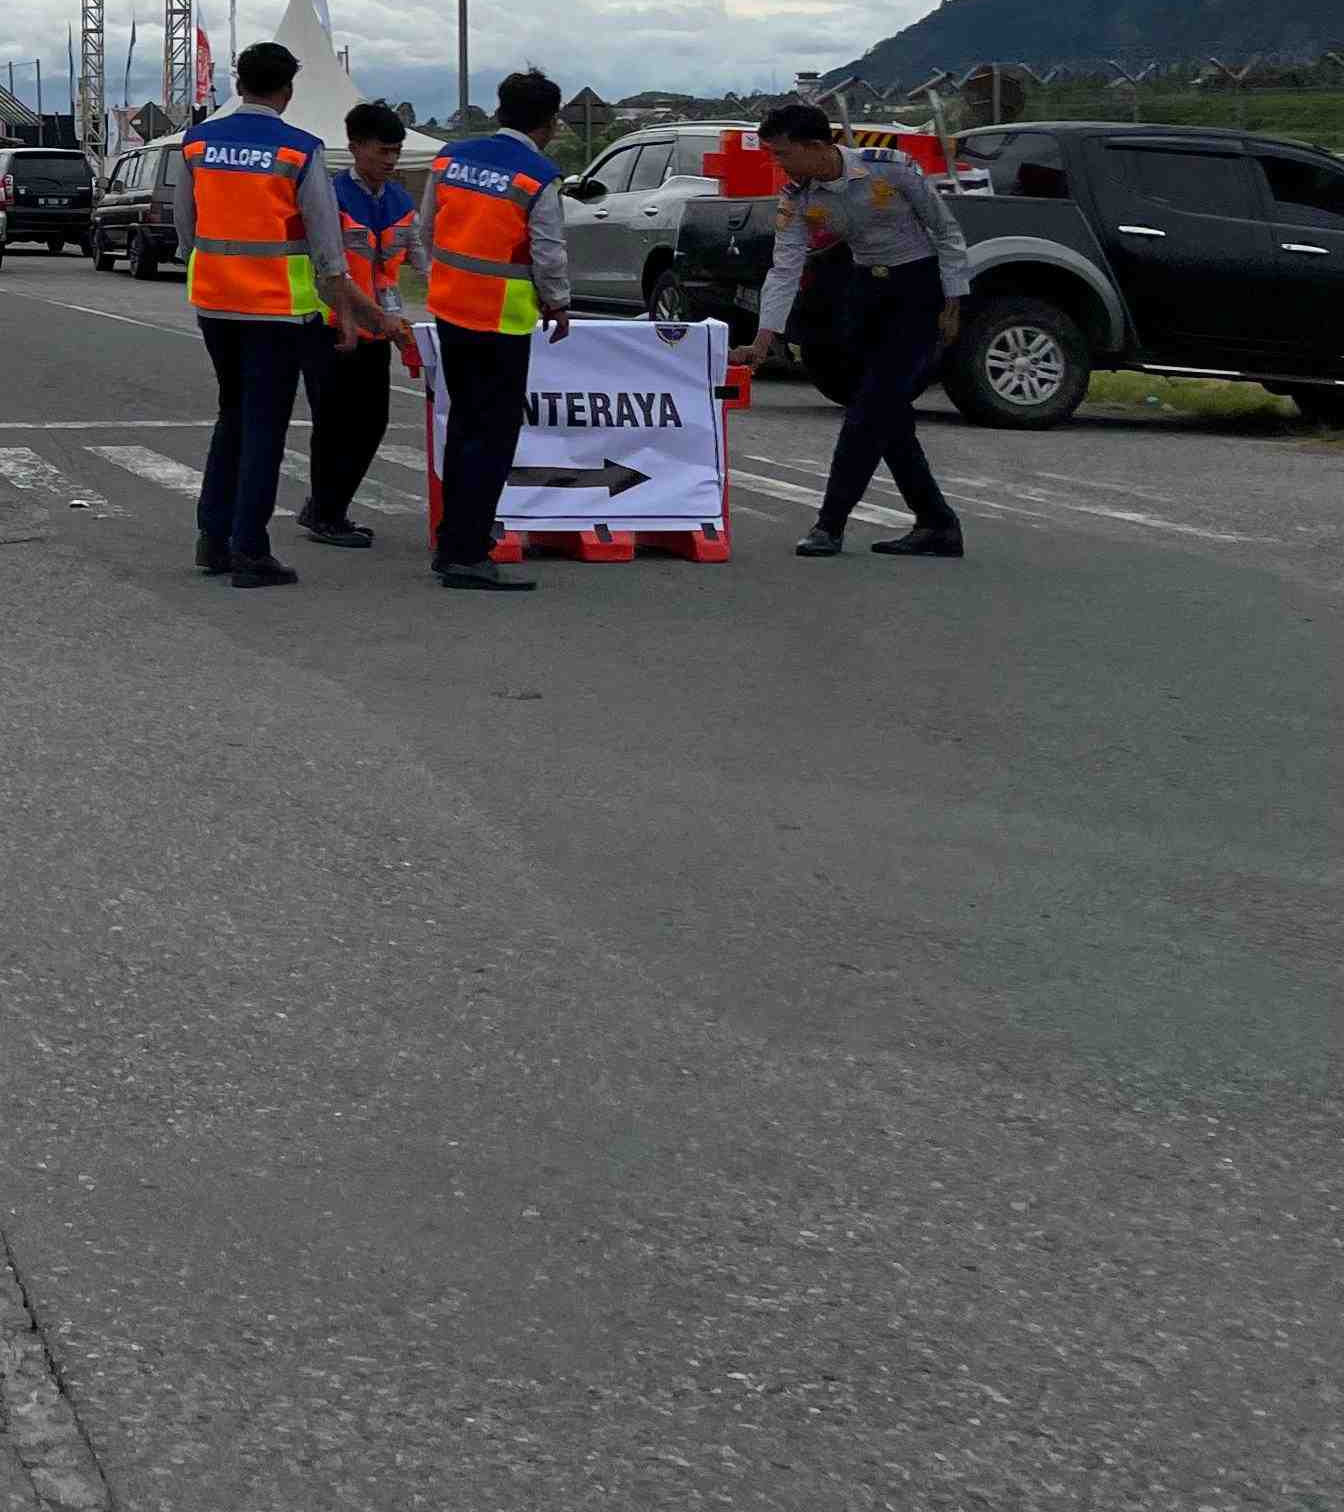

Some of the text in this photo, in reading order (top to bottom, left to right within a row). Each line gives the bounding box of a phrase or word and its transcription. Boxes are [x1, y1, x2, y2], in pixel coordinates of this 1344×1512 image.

[204, 146, 273, 168] DALOPS
[446, 163, 511, 192] DALOPS
[523, 392, 683, 428] NTERAYA
